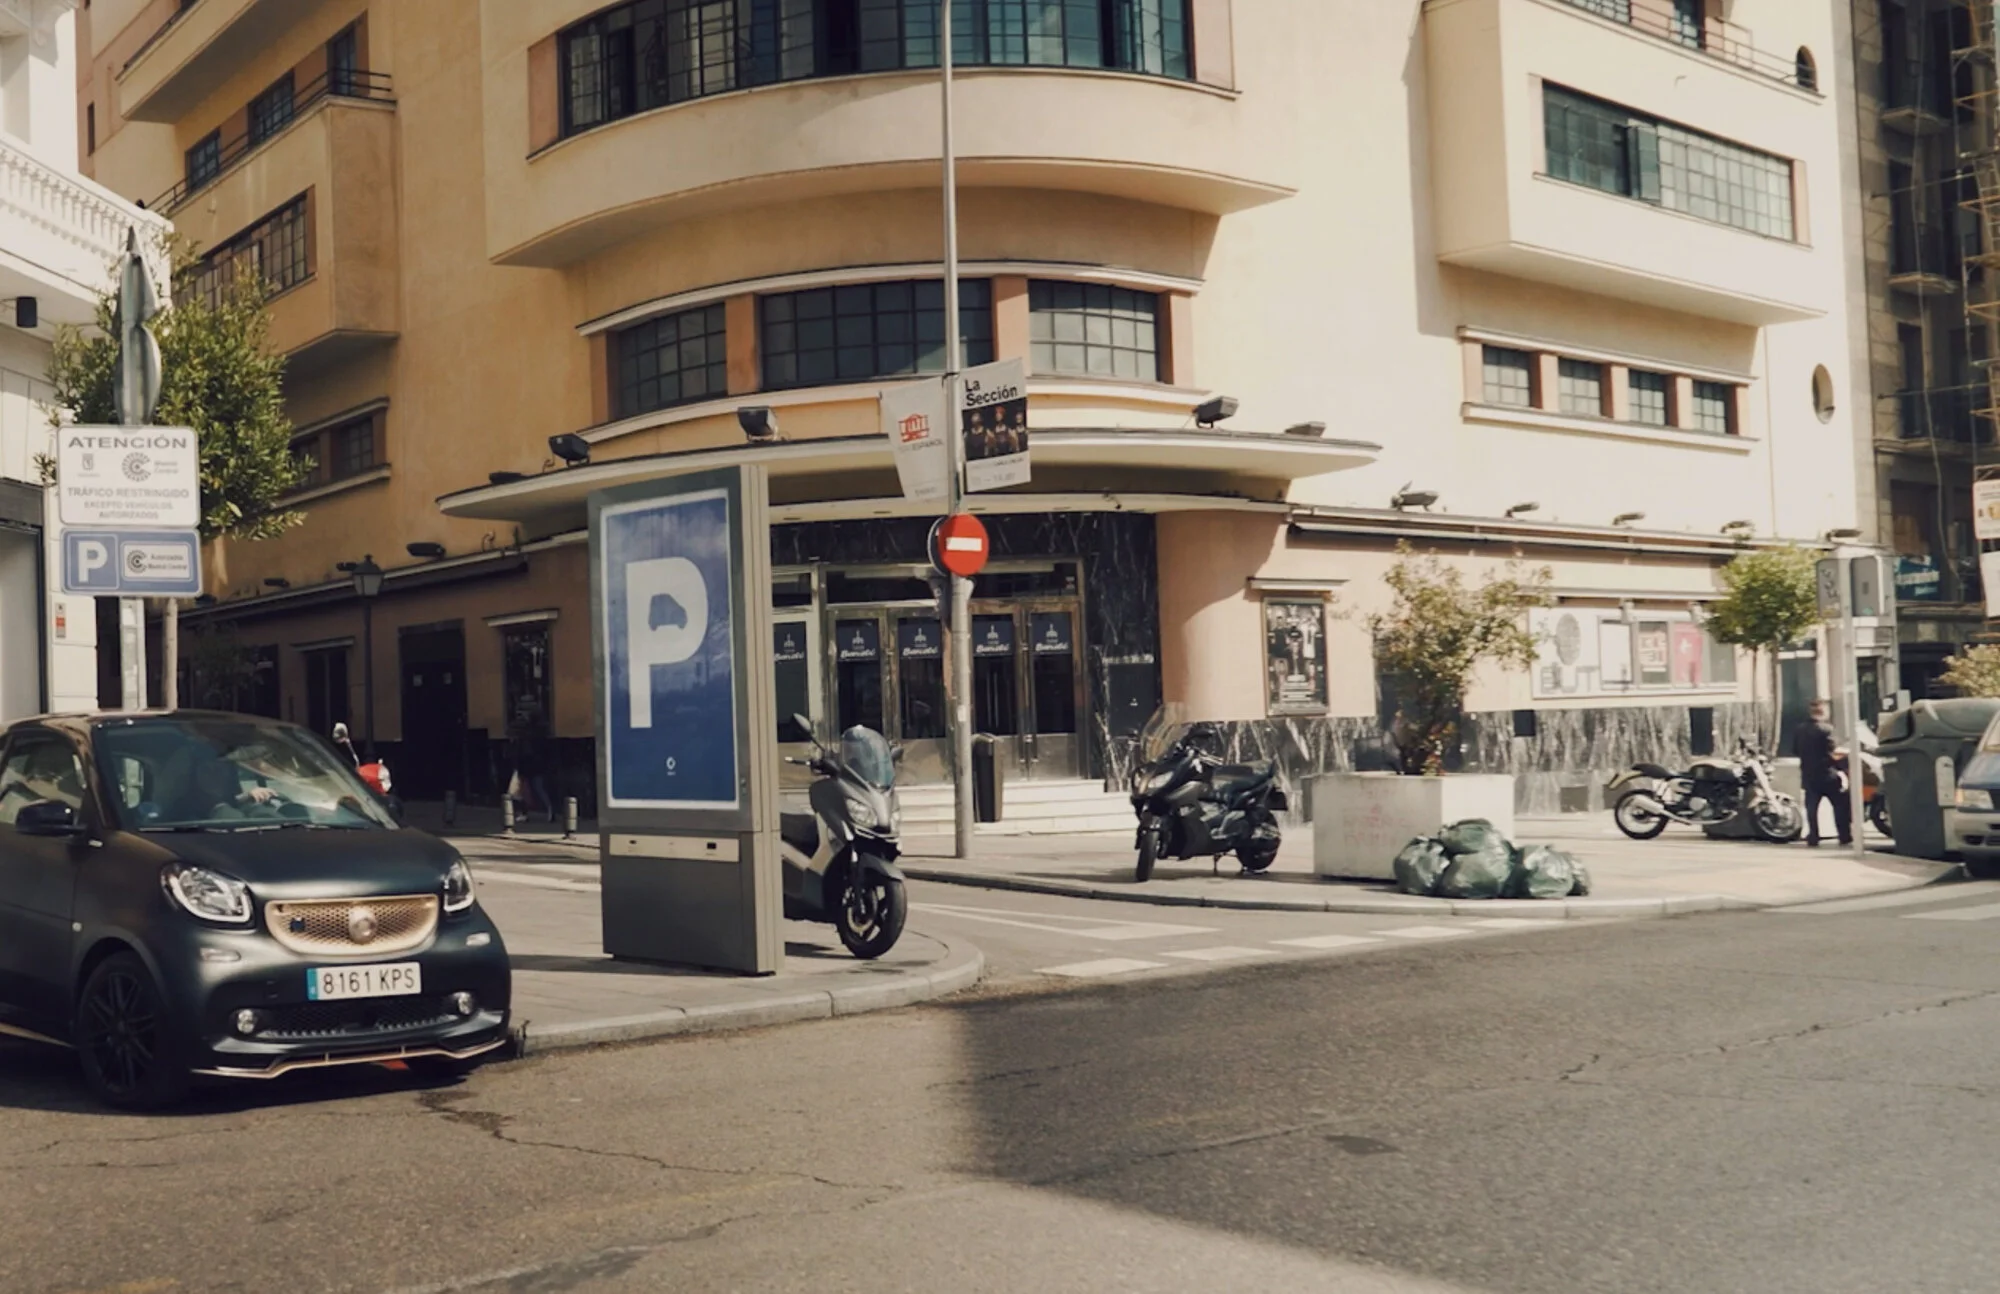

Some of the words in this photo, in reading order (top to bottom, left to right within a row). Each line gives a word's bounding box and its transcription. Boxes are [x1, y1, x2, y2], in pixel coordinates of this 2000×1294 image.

[965, 378, 980, 392] La
[966, 385, 1018, 406] Sección
[68, 433, 188, 449] ATENCIÓN
[67, 486, 114, 498] TRÁFICO
[116, 487, 190, 499] RESTRINGIDO
[78, 540, 108, 583] P
[626, 556, 709, 728] P
[323, 971, 371, 995] 8161
[379, 968, 415, 991] KPS
